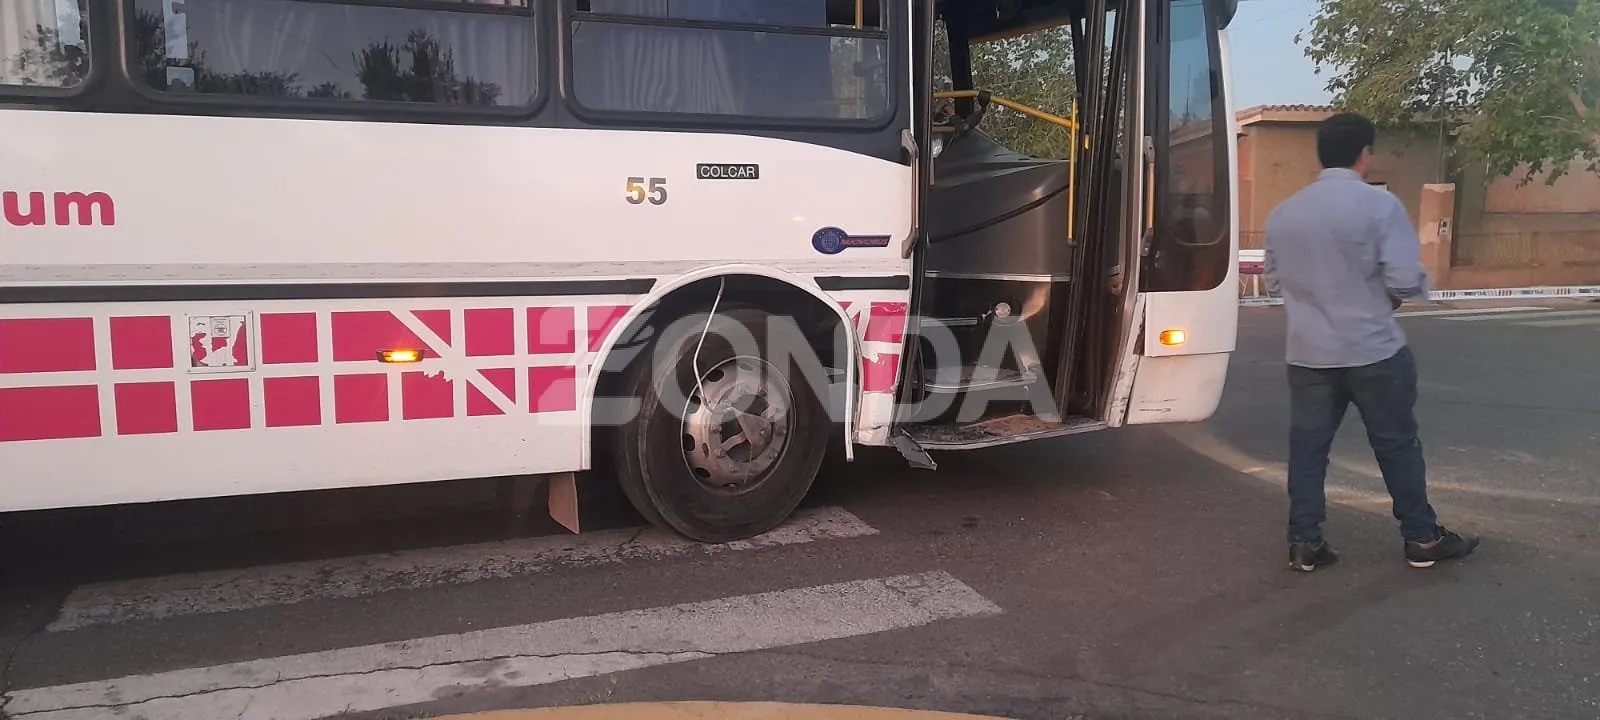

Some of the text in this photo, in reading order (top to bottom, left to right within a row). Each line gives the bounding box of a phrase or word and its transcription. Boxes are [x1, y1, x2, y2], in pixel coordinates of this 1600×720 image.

[700, 165, 755, 178] COLCAR
[625, 177, 667, 205] 55
[3, 191, 115, 226] um
